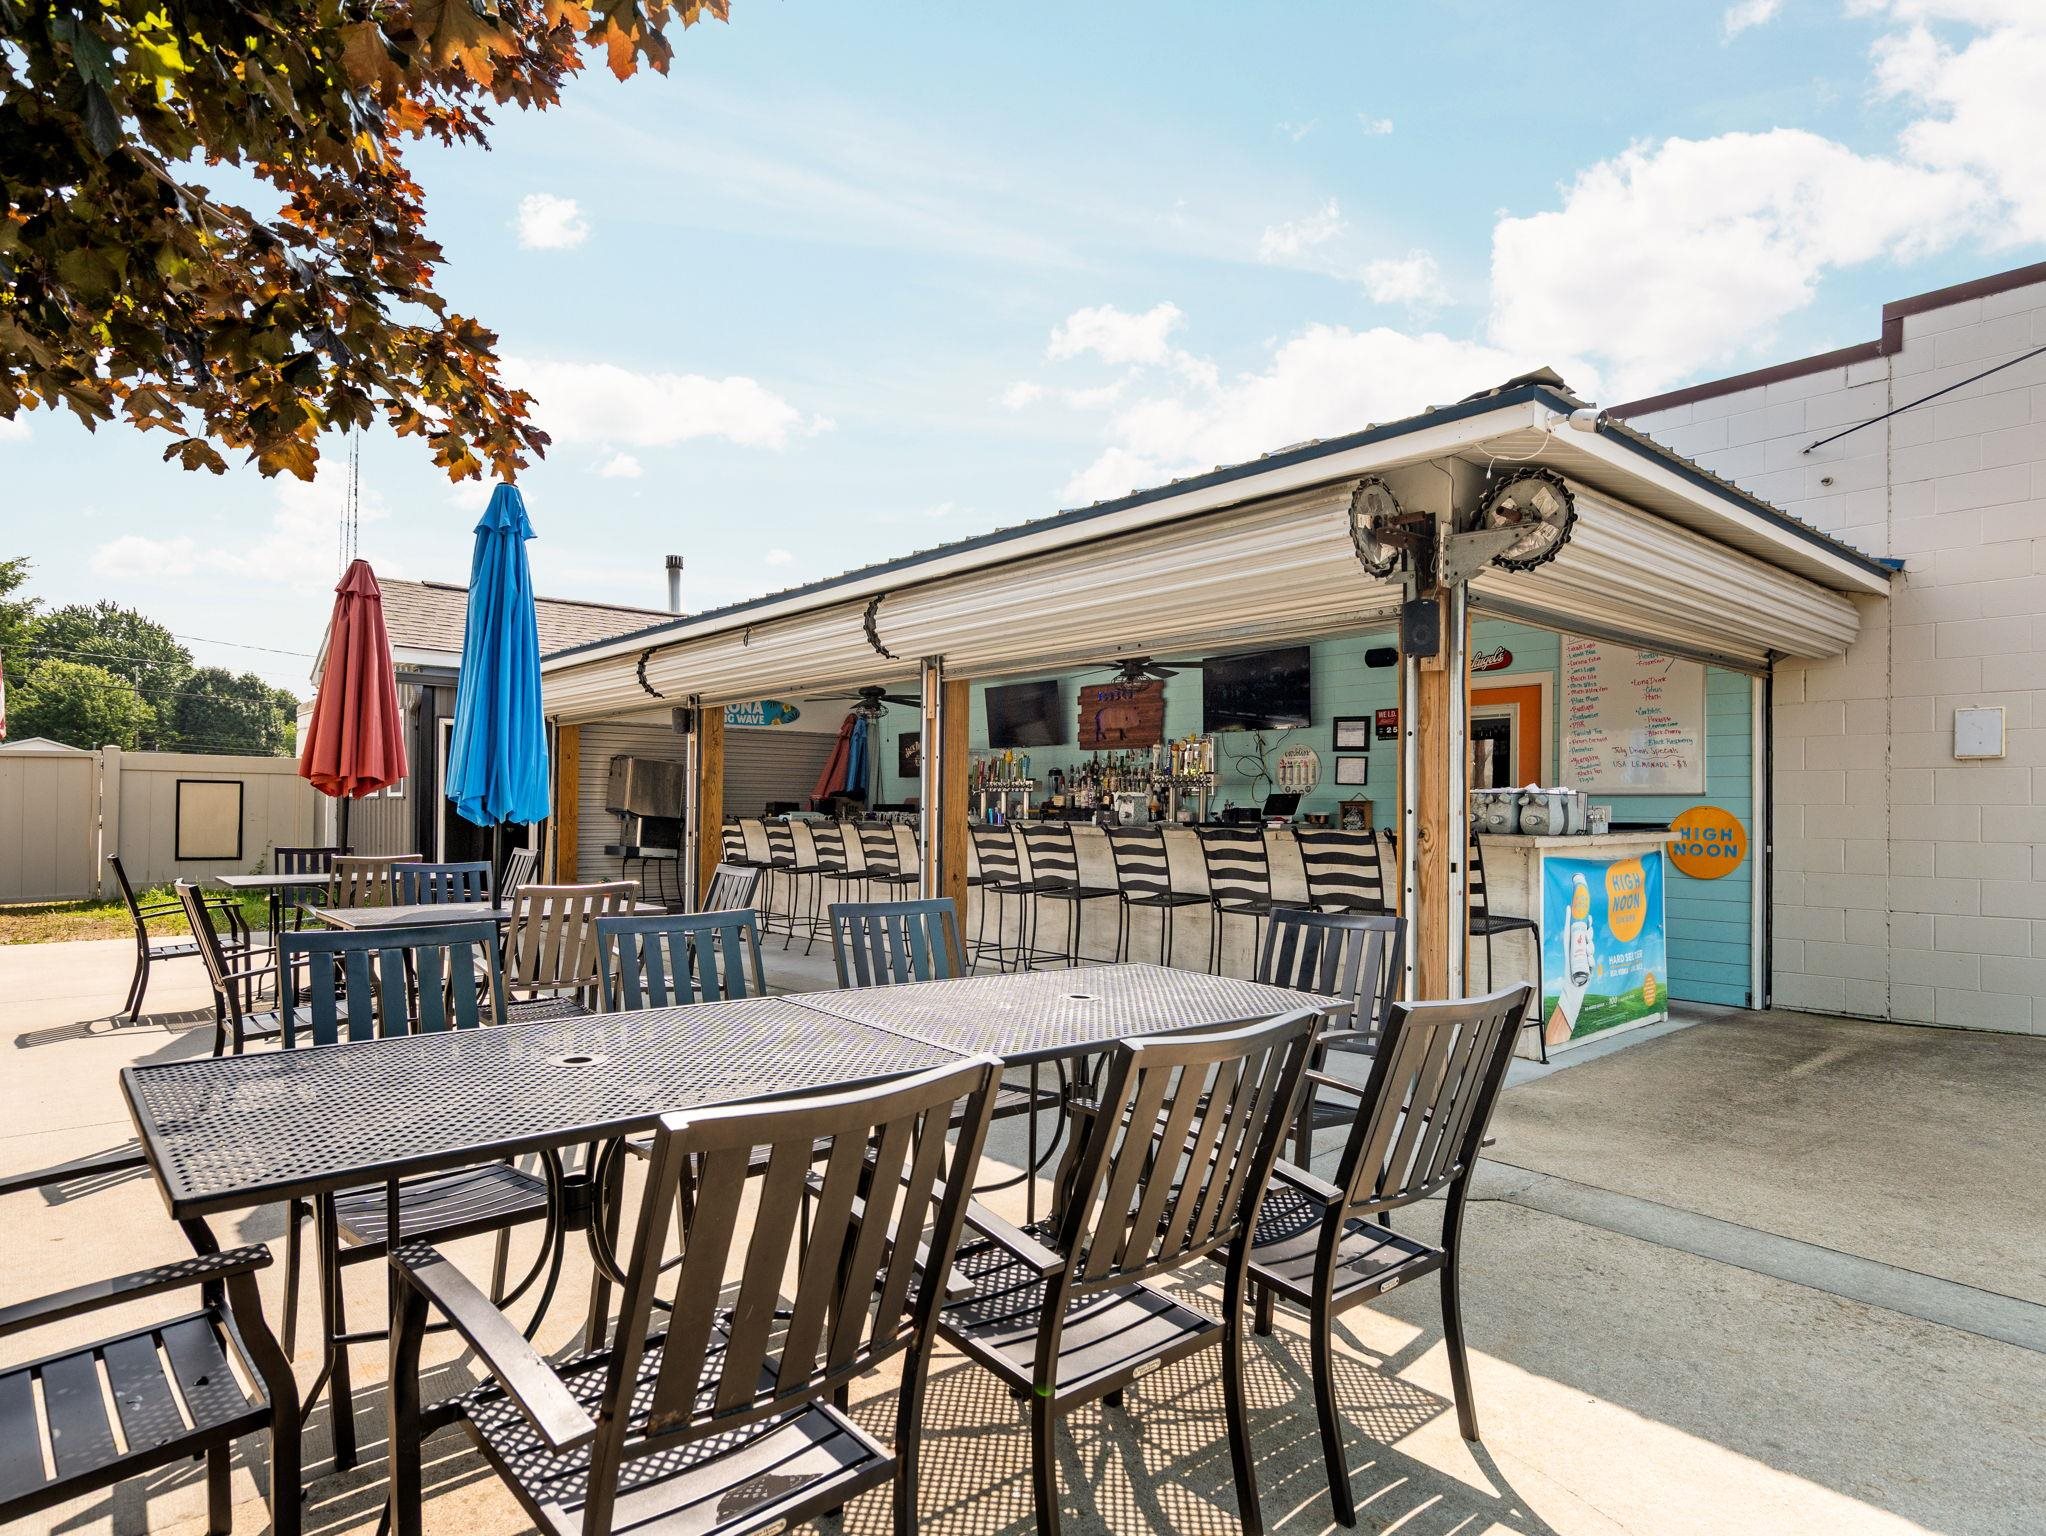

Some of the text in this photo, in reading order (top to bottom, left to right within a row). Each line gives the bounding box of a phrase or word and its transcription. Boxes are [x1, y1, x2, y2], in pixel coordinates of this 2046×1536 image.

[724, 701, 764, 714] ONA
[736, 715, 765, 725] WAVE
[1680, 826, 1733, 842] HIGH
[1673, 843, 1738, 859] NOON
[1612, 873, 1640, 892] HIGH
[1612, 892, 1640, 913] NOON
